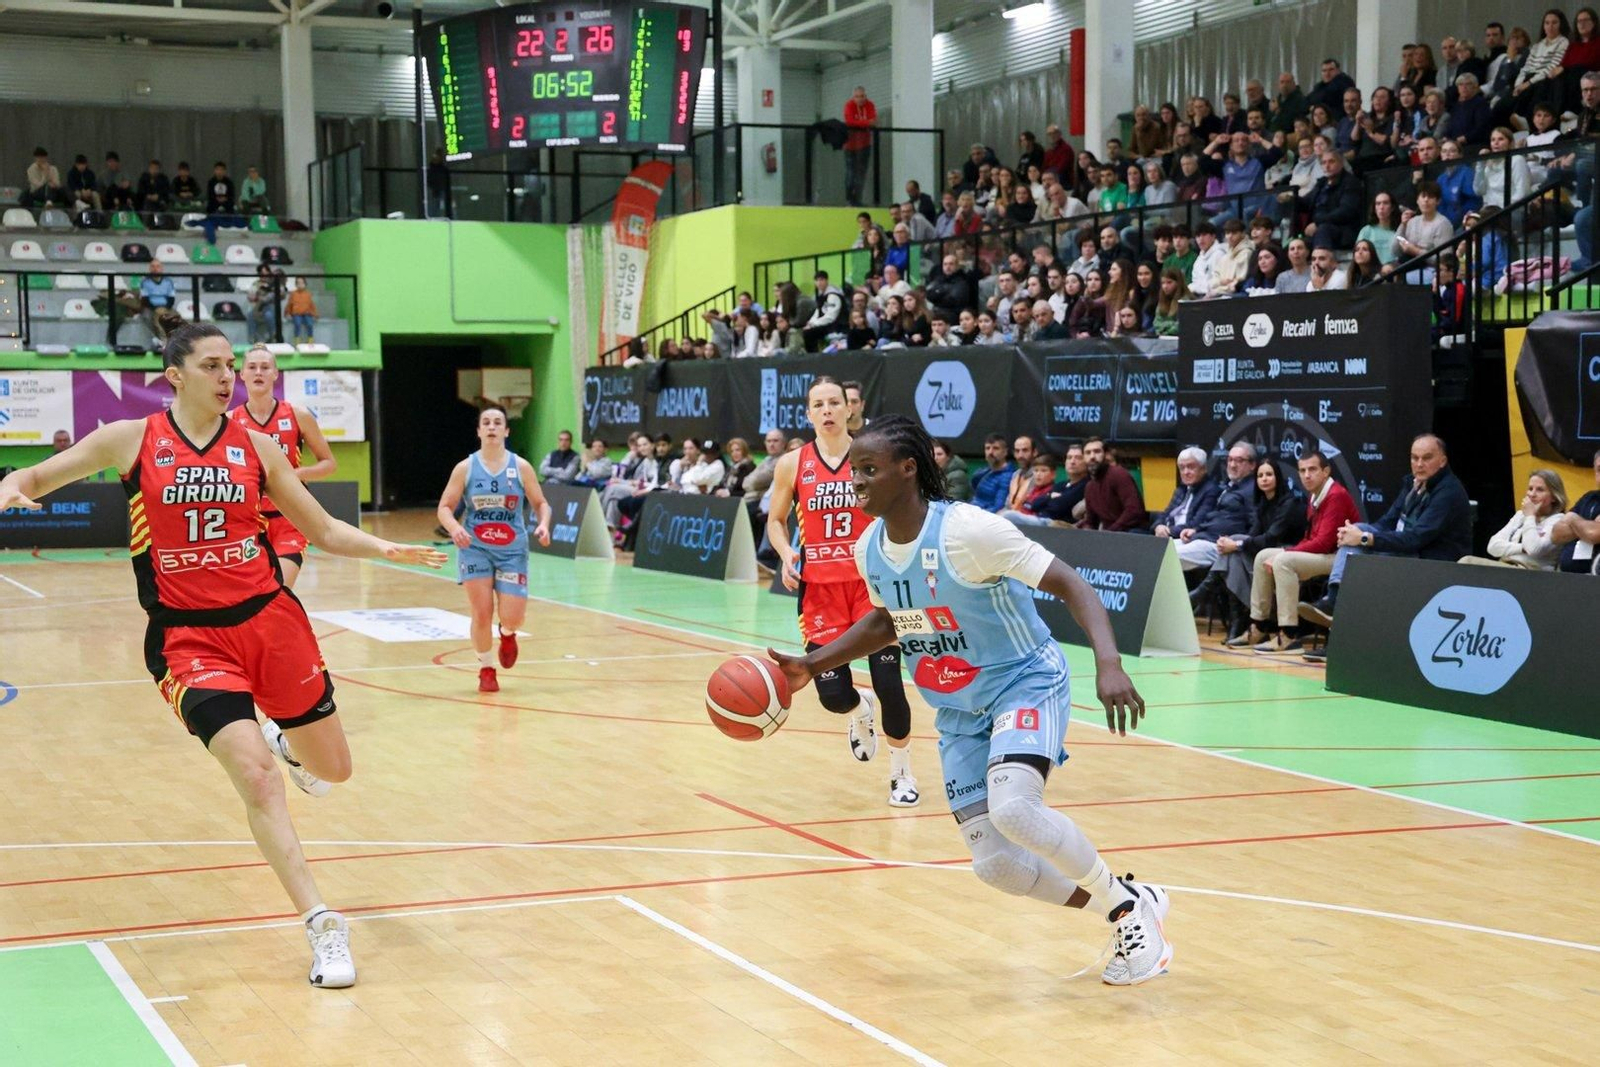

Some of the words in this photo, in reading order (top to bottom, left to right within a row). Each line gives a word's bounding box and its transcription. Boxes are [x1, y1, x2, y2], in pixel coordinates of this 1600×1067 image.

[515, 14, 536, 25] LOCAL
[516, 30, 545, 57] 22
[555, 30, 569, 53] 2
[586, 25, 614, 54] 26
[532, 70, 593, 99] 06:52
[511, 116, 525, 139] 2
[602, 111, 616, 135] 2
[625, 263, 637, 297] VIGO
[621, 302, 632, 320] DE
[1214, 325, 1235, 337] CELTA
[1282, 319, 1317, 338] Recalvi
[1324, 313, 1359, 336] femxa
[1048, 370, 1112, 391] CONCELLERÍA
[656, 387, 709, 418] ABANCA
[927, 380, 963, 419] Zorka
[1130, 401, 1151, 421] DE
[1153, 400, 1178, 421] VIG
[779, 405, 793, 429] DE
[1052, 406, 1101, 422] DEPORTES
[175, 467, 230, 484] SPAR
[162, 484, 246, 505] GIRONA
[807, 493, 858, 512] GIRON
[51, 502, 92, 515] BENE
[184, 508, 227, 542] 12
[822, 511, 853, 540] 13
[161, 544, 243, 570] SPAR
[892, 579, 913, 609] 11
[1431, 605, 1506, 668] Zorka
[955, 778, 987, 797] travel
